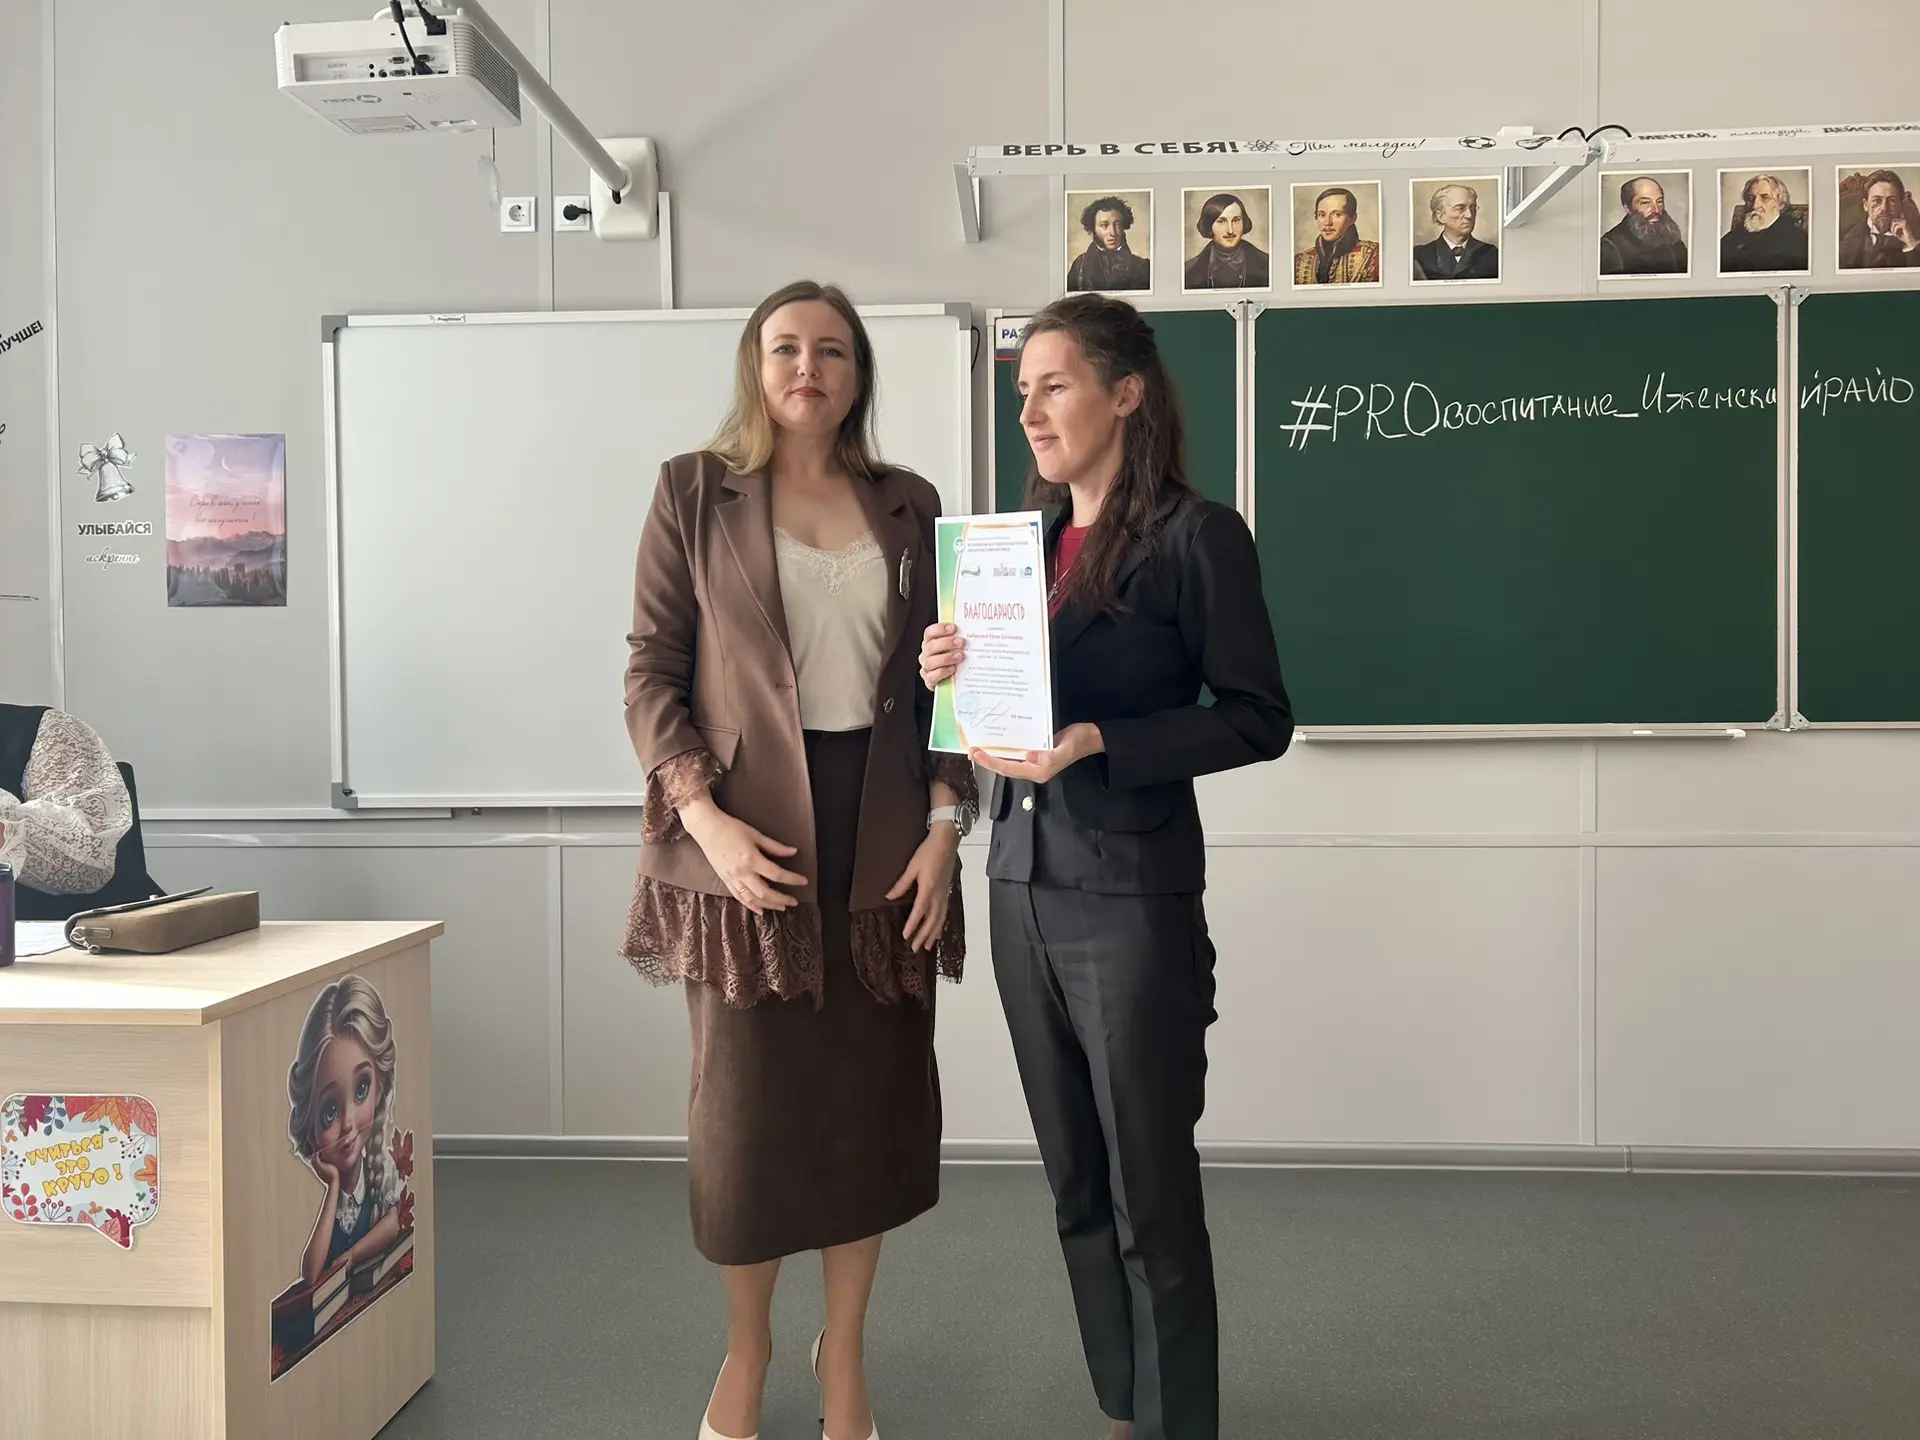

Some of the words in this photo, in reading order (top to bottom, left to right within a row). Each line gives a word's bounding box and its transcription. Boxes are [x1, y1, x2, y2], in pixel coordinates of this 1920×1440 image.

[1003, 144, 1087, 157] ВЕРЬ
[1099, 143, 1121, 155] В
[1134, 141, 1240, 155] СЕБЯ!
[1285, 141, 1336, 156] Ты
[1343, 138, 1427, 159] молодец!
[77, 521, 152, 536] УЛЫБАЙСЯ
[85, 546, 140, 570] искренне
[963, 602, 1026, 621] БЛАГОДАРНОСТЬ
[25, 1134, 104, 1165] УЧИТЬСЯ
[55, 1156, 90, 1175] ЭТО
